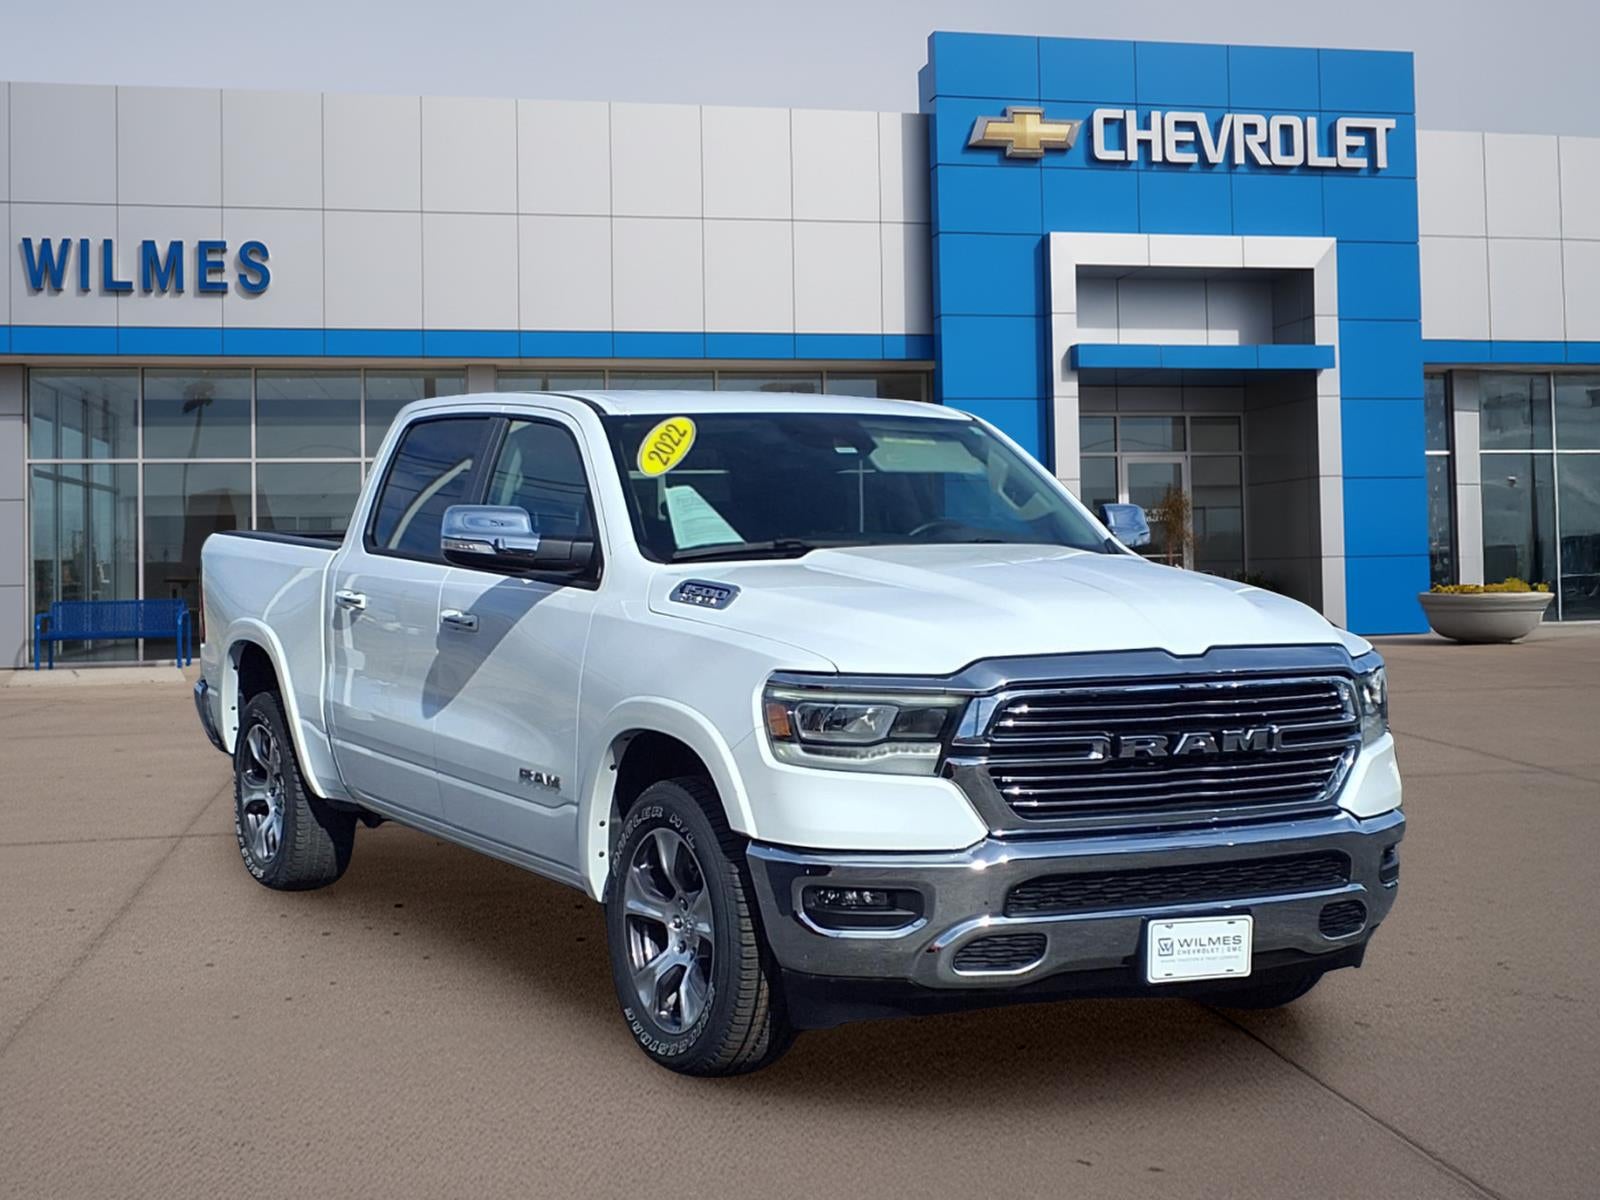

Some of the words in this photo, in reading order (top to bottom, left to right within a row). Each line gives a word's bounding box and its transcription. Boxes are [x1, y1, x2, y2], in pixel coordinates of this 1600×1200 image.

[1093, 108, 1396, 169] CHEVROLET
[22, 237, 271, 293] WILMES
[648, 424, 687, 466] 2022
[1118, 727, 1269, 758] RAM
[519, 767, 561, 788] RAM
[1177, 935, 1242, 949] WILMES
[1177, 947, 1220, 956] CHEVROLET
